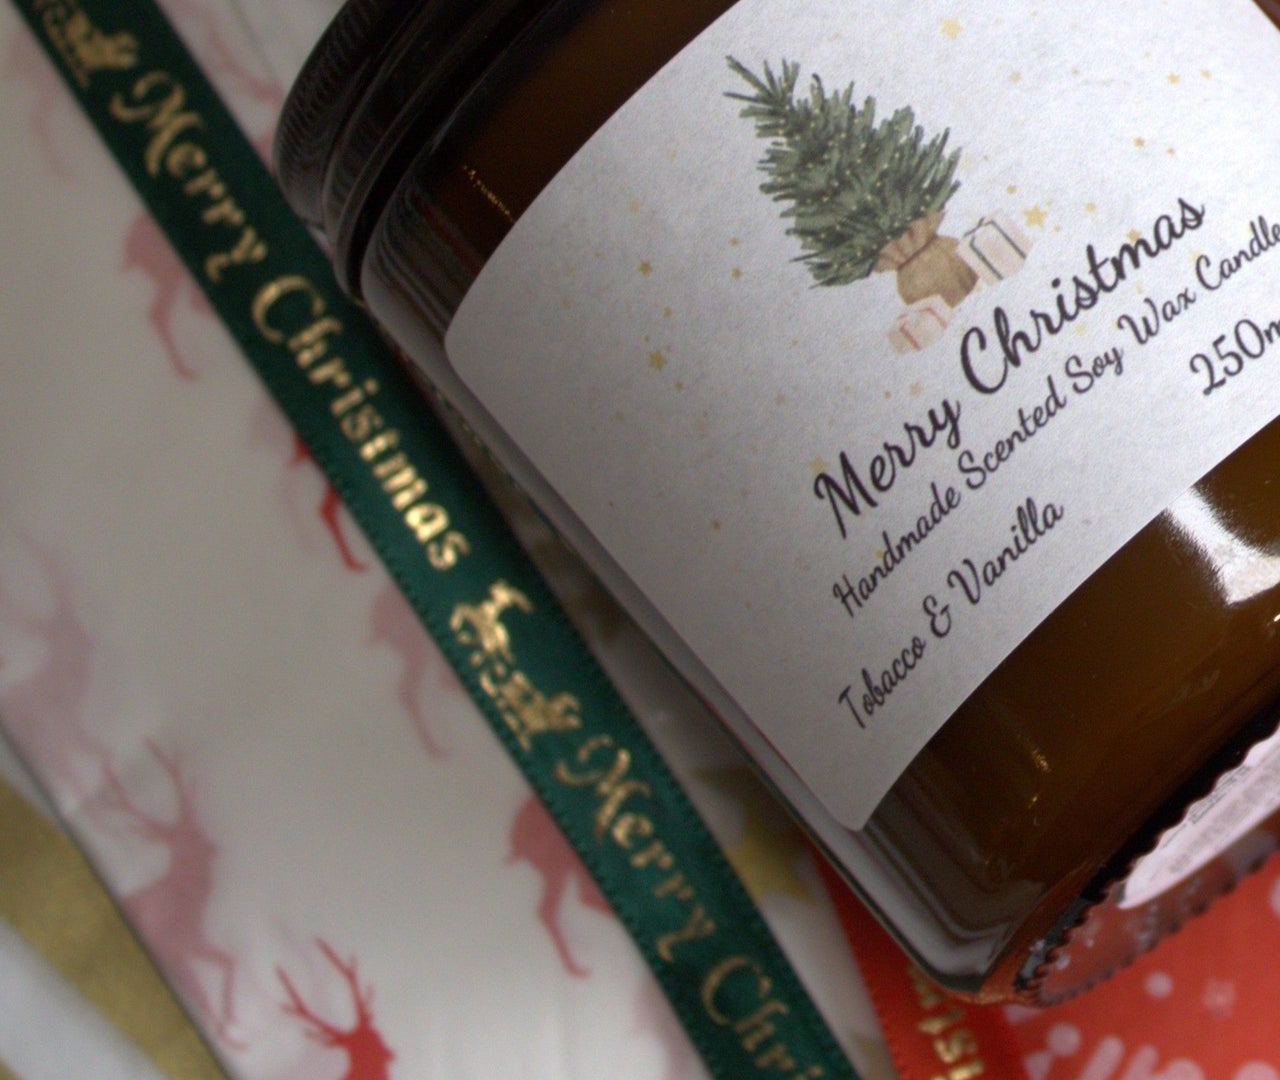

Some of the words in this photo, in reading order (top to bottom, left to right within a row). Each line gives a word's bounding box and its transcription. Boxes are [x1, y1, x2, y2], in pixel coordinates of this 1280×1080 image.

[108, 68, 268, 283] Merry
[251, 275, 471, 571] Christmas
[812, 398, 961, 540] Merry
[959, 196, 1206, 396] Christmas
[832, 485, 961, 618] Handmade
[958, 391, 1068, 491] Scented
[1064, 344, 1125, 397] Soy
[1116, 287, 1198, 347] Wax
[837, 635, 929, 731] Tobacco
[921, 594, 953, 639] &
[947, 496, 1065, 606] Vanilla
[556, 734, 716, 963] Merry
